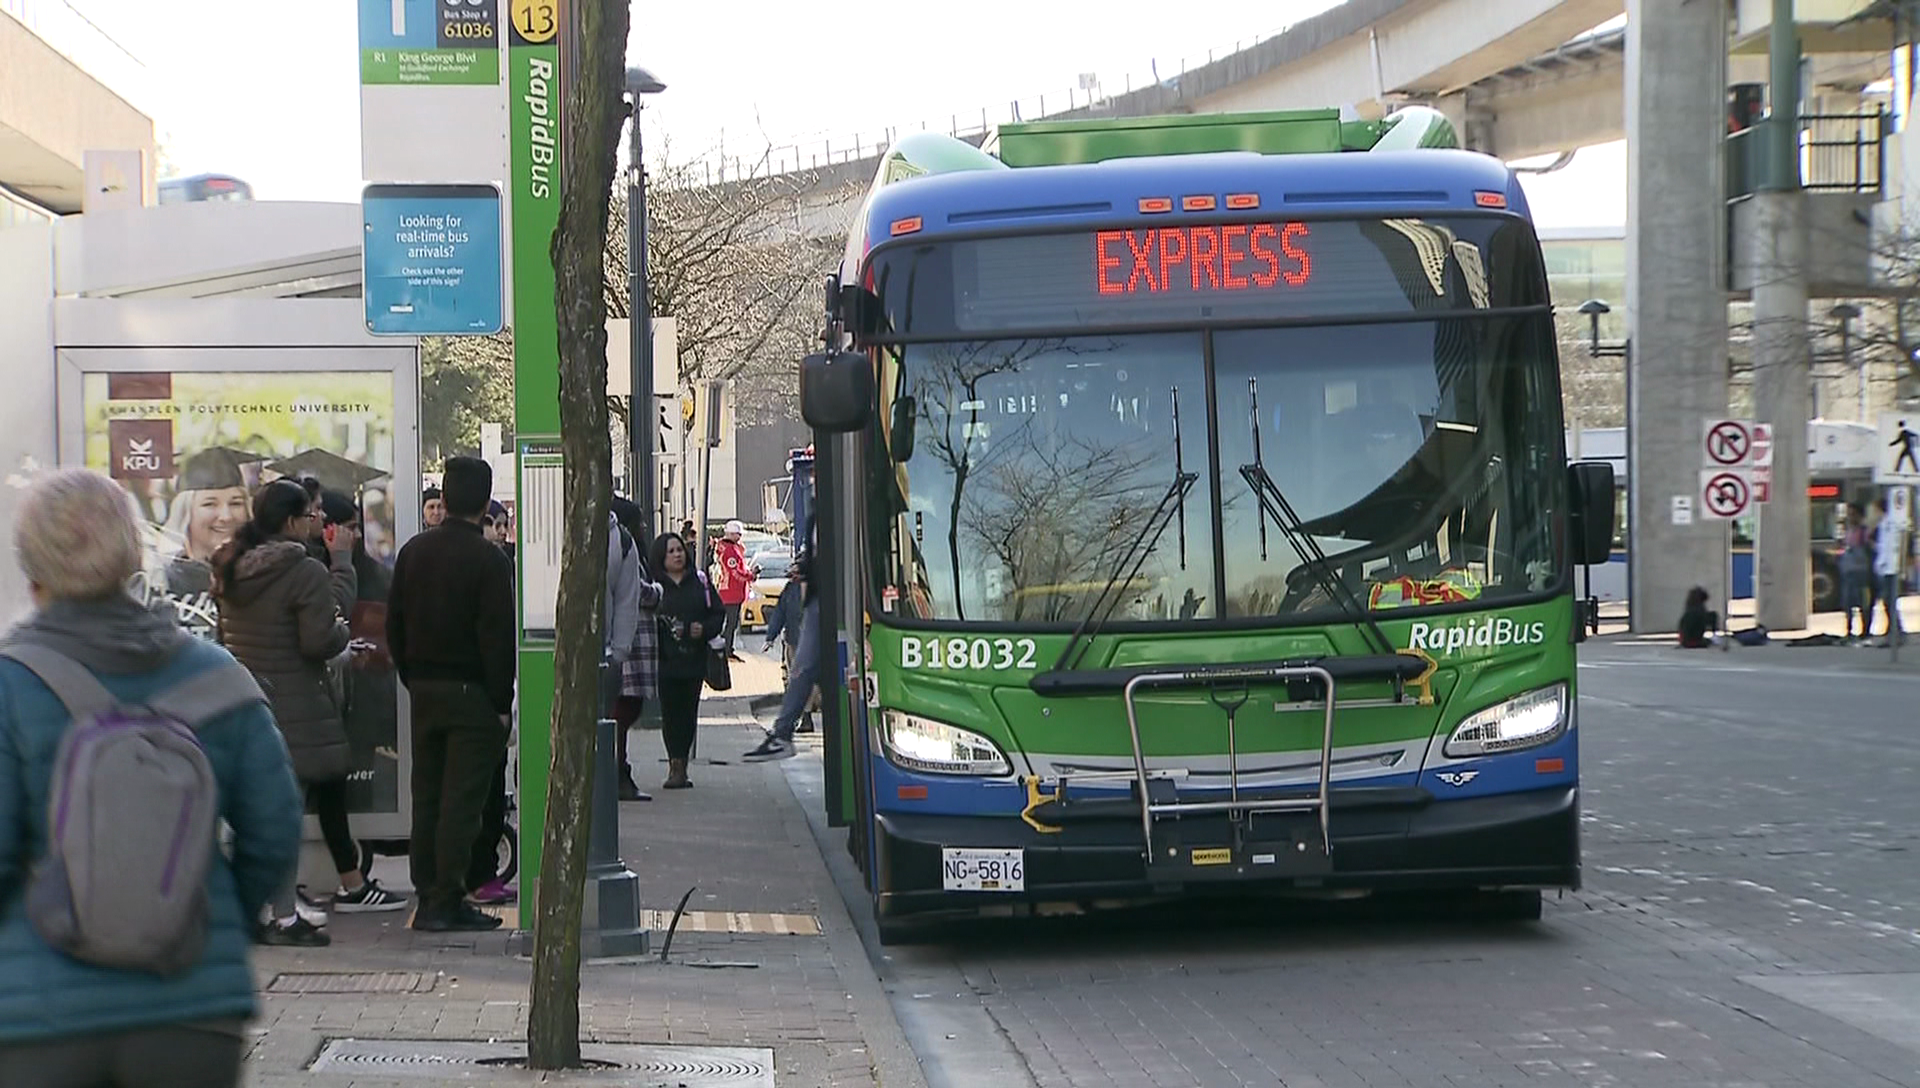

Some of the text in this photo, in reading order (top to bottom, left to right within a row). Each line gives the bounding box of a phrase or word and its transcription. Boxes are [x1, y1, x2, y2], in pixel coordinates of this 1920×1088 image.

[444, 10, 460, 19] Bus
[461, 9, 480, 20] Stop
[521, 5, 554, 34] 13
[444, 22, 493, 38] 61036
[373, 52, 477, 64] R1 King George Blvd
[524, 58, 555, 198] RapidBus
[400, 214, 462, 230] Looking for
[396, 230, 469, 243] real-time bus
[408, 245, 455, 258] arrivals?
[1096, 222, 1312, 293] EXPRESS
[402, 266, 464, 275] Check out the other
[408, 277, 460, 287] side of this sign!
[189, 404, 283, 414] POLYTECHNIC
[289, 403, 371, 413] UNIVERSITY
[122, 456, 160, 470] KPU
[1408, 617, 1545, 655] RapidBus
[901, 636, 1037, 670] B18032
